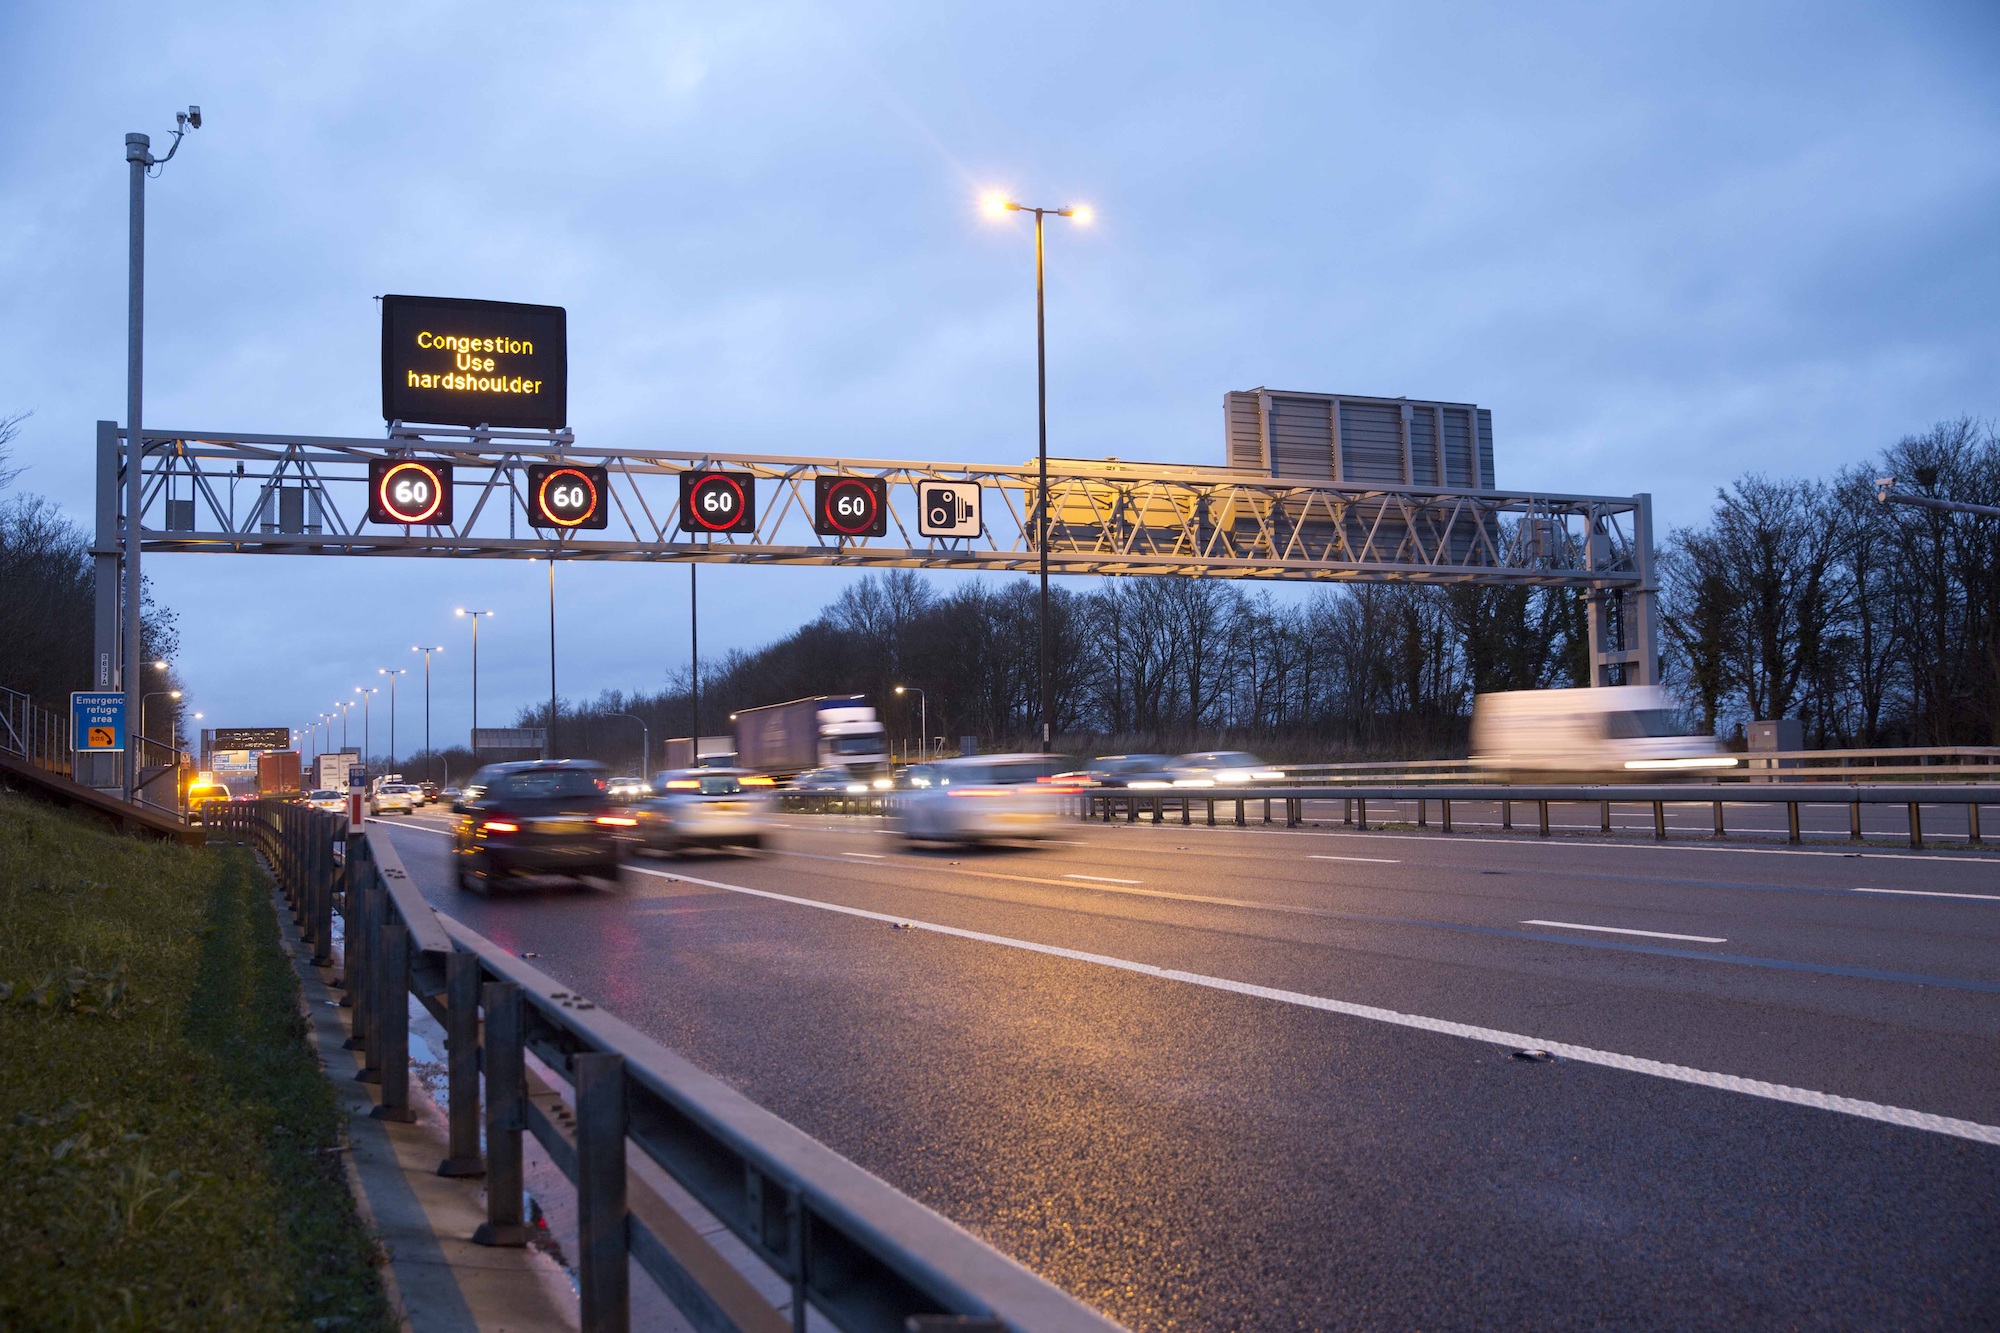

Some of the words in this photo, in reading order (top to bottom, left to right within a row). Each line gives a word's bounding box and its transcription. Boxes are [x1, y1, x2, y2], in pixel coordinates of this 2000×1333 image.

[417, 331, 533, 355] Congestion
[456, 353, 495, 372] Use
[407, 370, 542, 394] hardshoulder
[395, 480, 428, 503] 60
[553, 486, 584, 507] 60
[703, 491, 732, 512] 60
[837, 496, 865, 516] 60
[76, 696, 124, 706] Emergenc
[86, 706, 118, 715] refuge
[351, 769, 364, 777] 183
